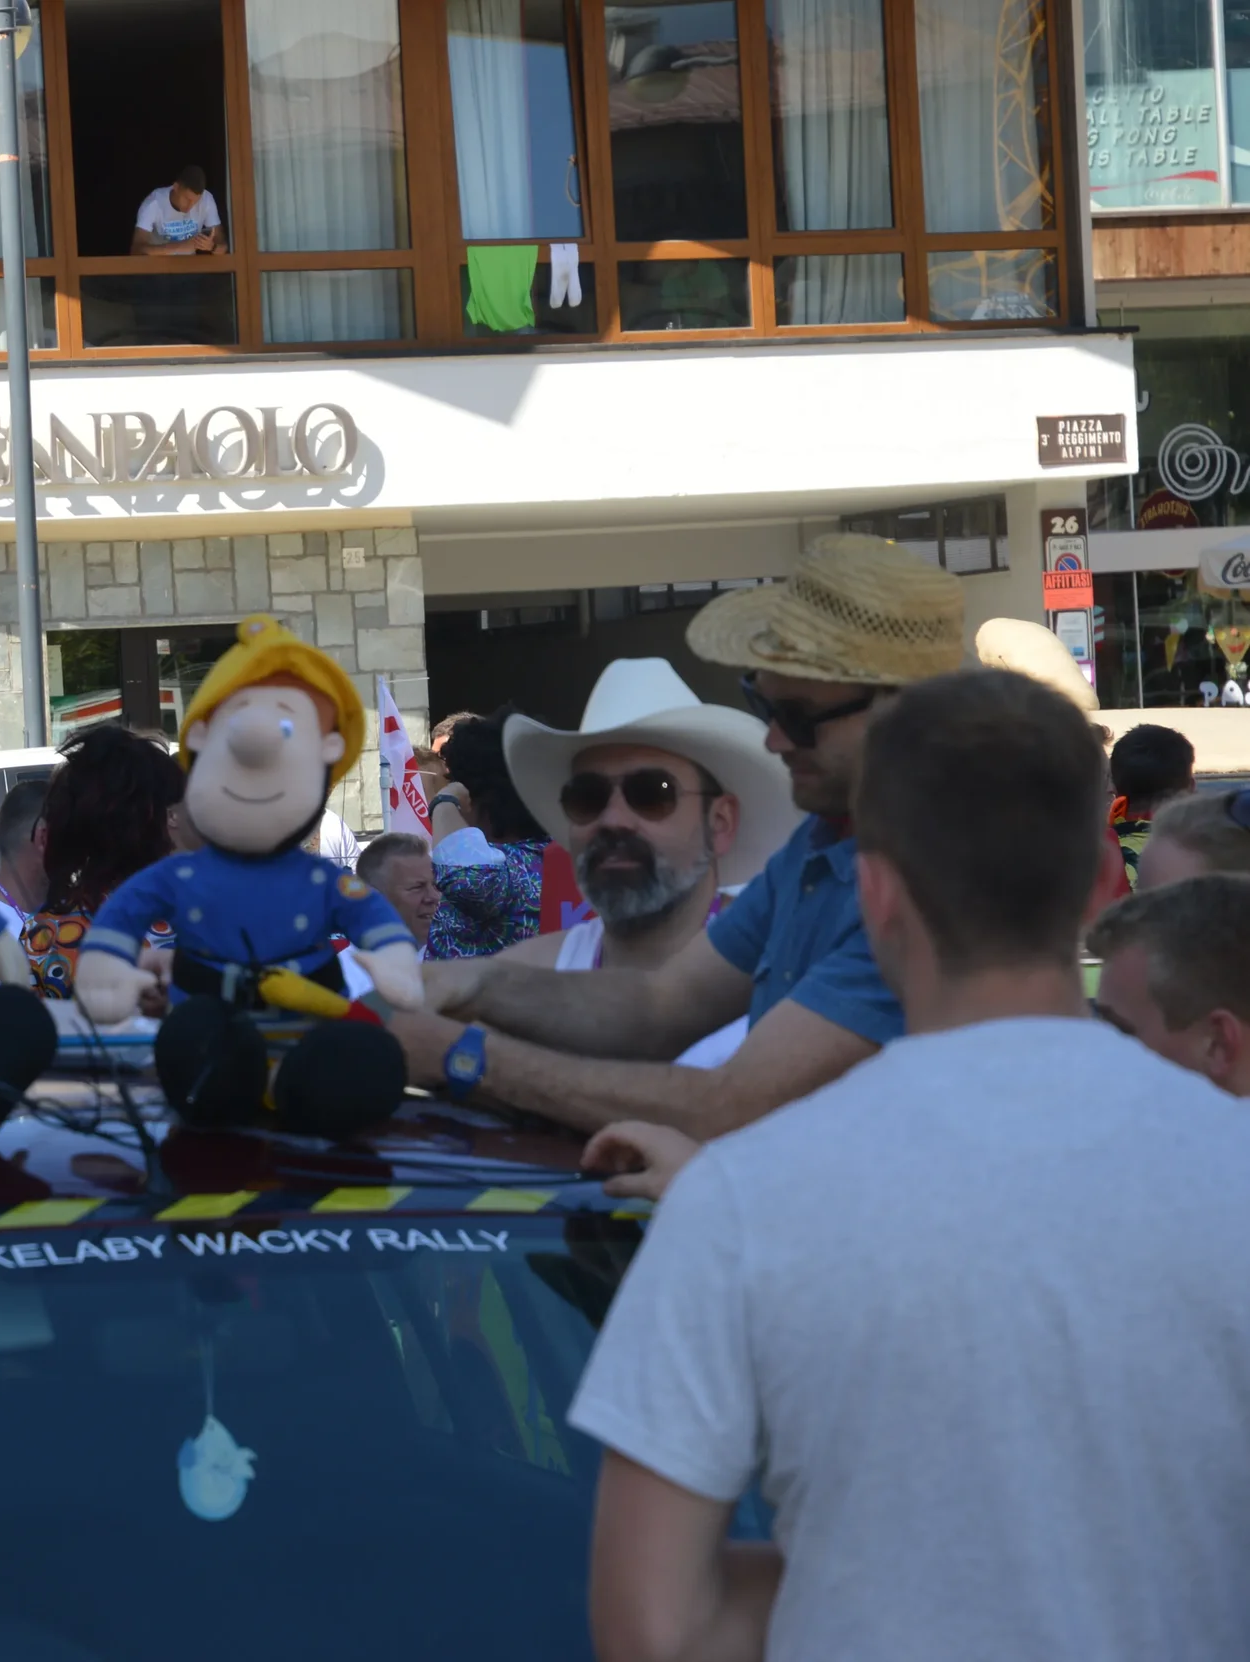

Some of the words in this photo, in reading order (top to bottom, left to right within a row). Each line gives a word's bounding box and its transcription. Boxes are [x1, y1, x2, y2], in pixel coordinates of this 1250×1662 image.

[1138, 104, 1212, 125] TABLE
[1113, 125, 1178, 147] PONG
[1127, 147, 1198, 167] TABLE
[1058, 419, 1103, 432] PIAZZA
[1058, 431, 1122, 445] REGGIMENTO
[1062, 445, 1102, 458] ALPINI
[1050, 515, 1079, 534] 26
[1045, 573, 1090, 589] AFFITTASI
[178, 1228, 352, 1256] WACKY
[367, 1228, 509, 1251] RALLY
